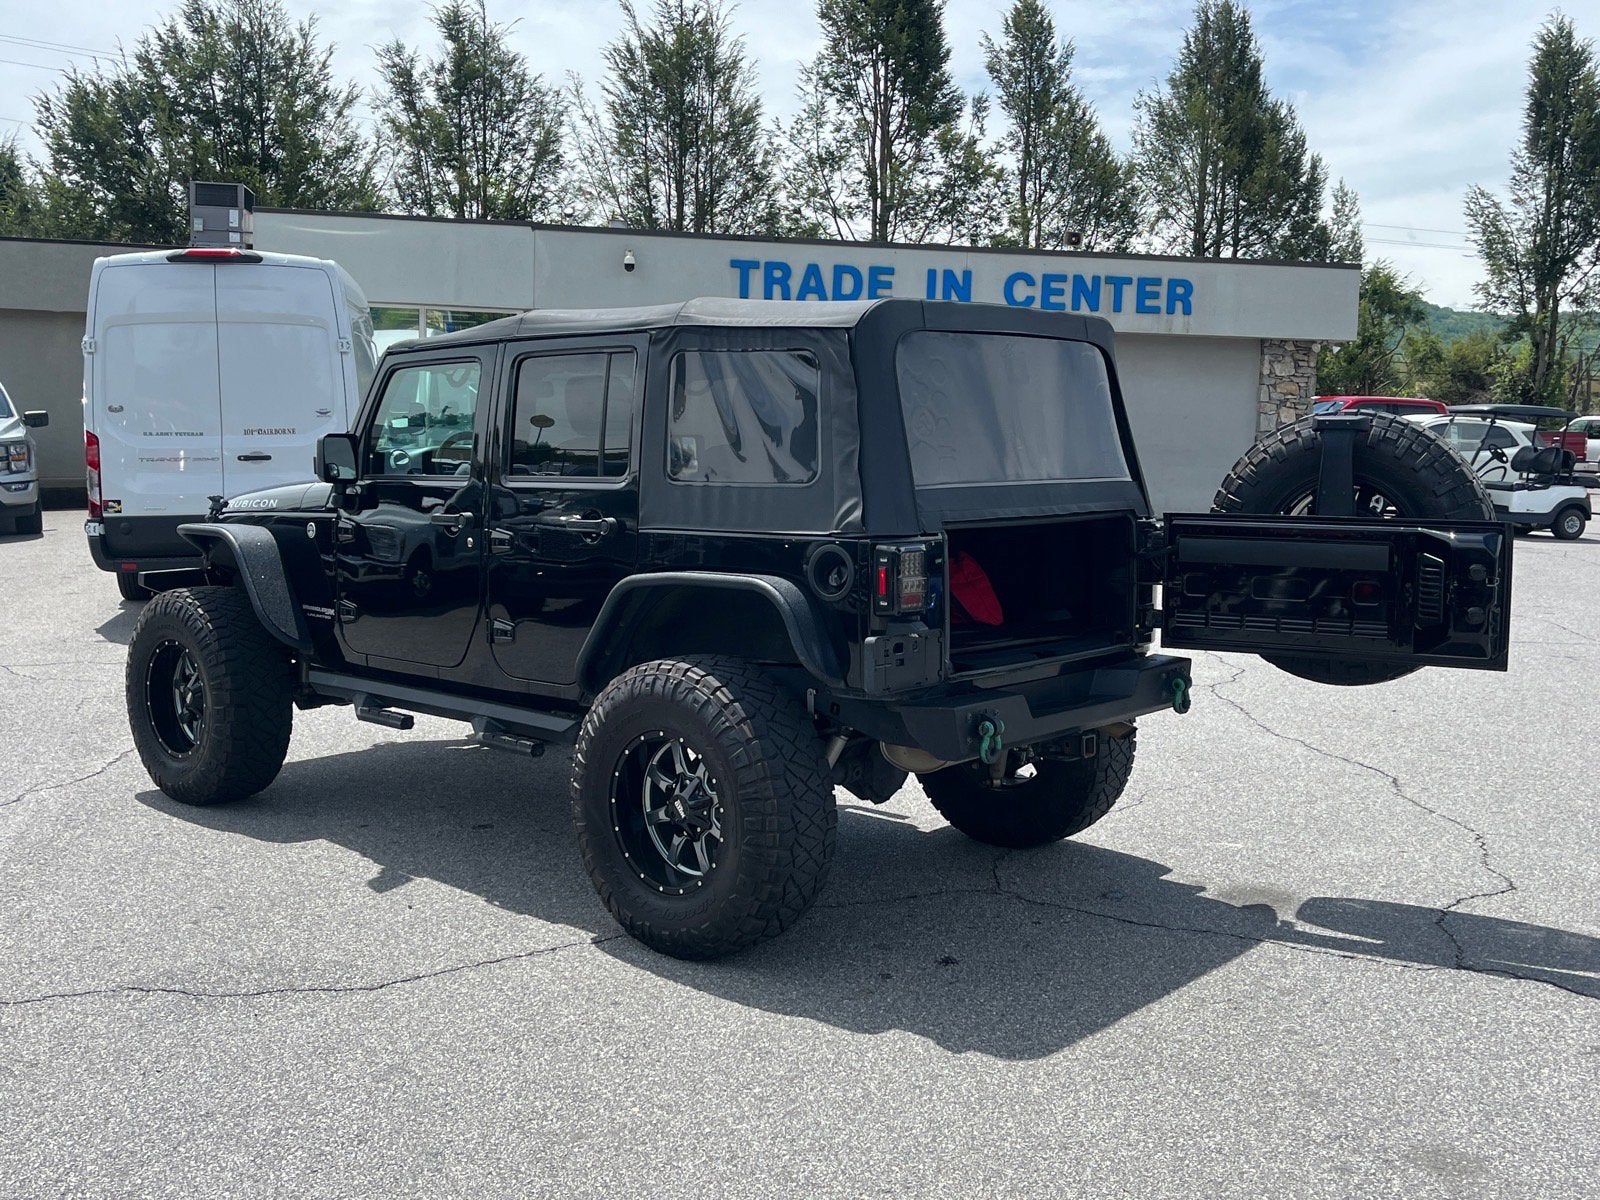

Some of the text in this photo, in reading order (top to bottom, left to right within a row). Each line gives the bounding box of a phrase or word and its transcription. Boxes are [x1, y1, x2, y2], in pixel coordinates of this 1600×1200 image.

[730, 259, 1194, 315] TRADE IN CENTER
[227, 498, 278, 508] RUBICON
